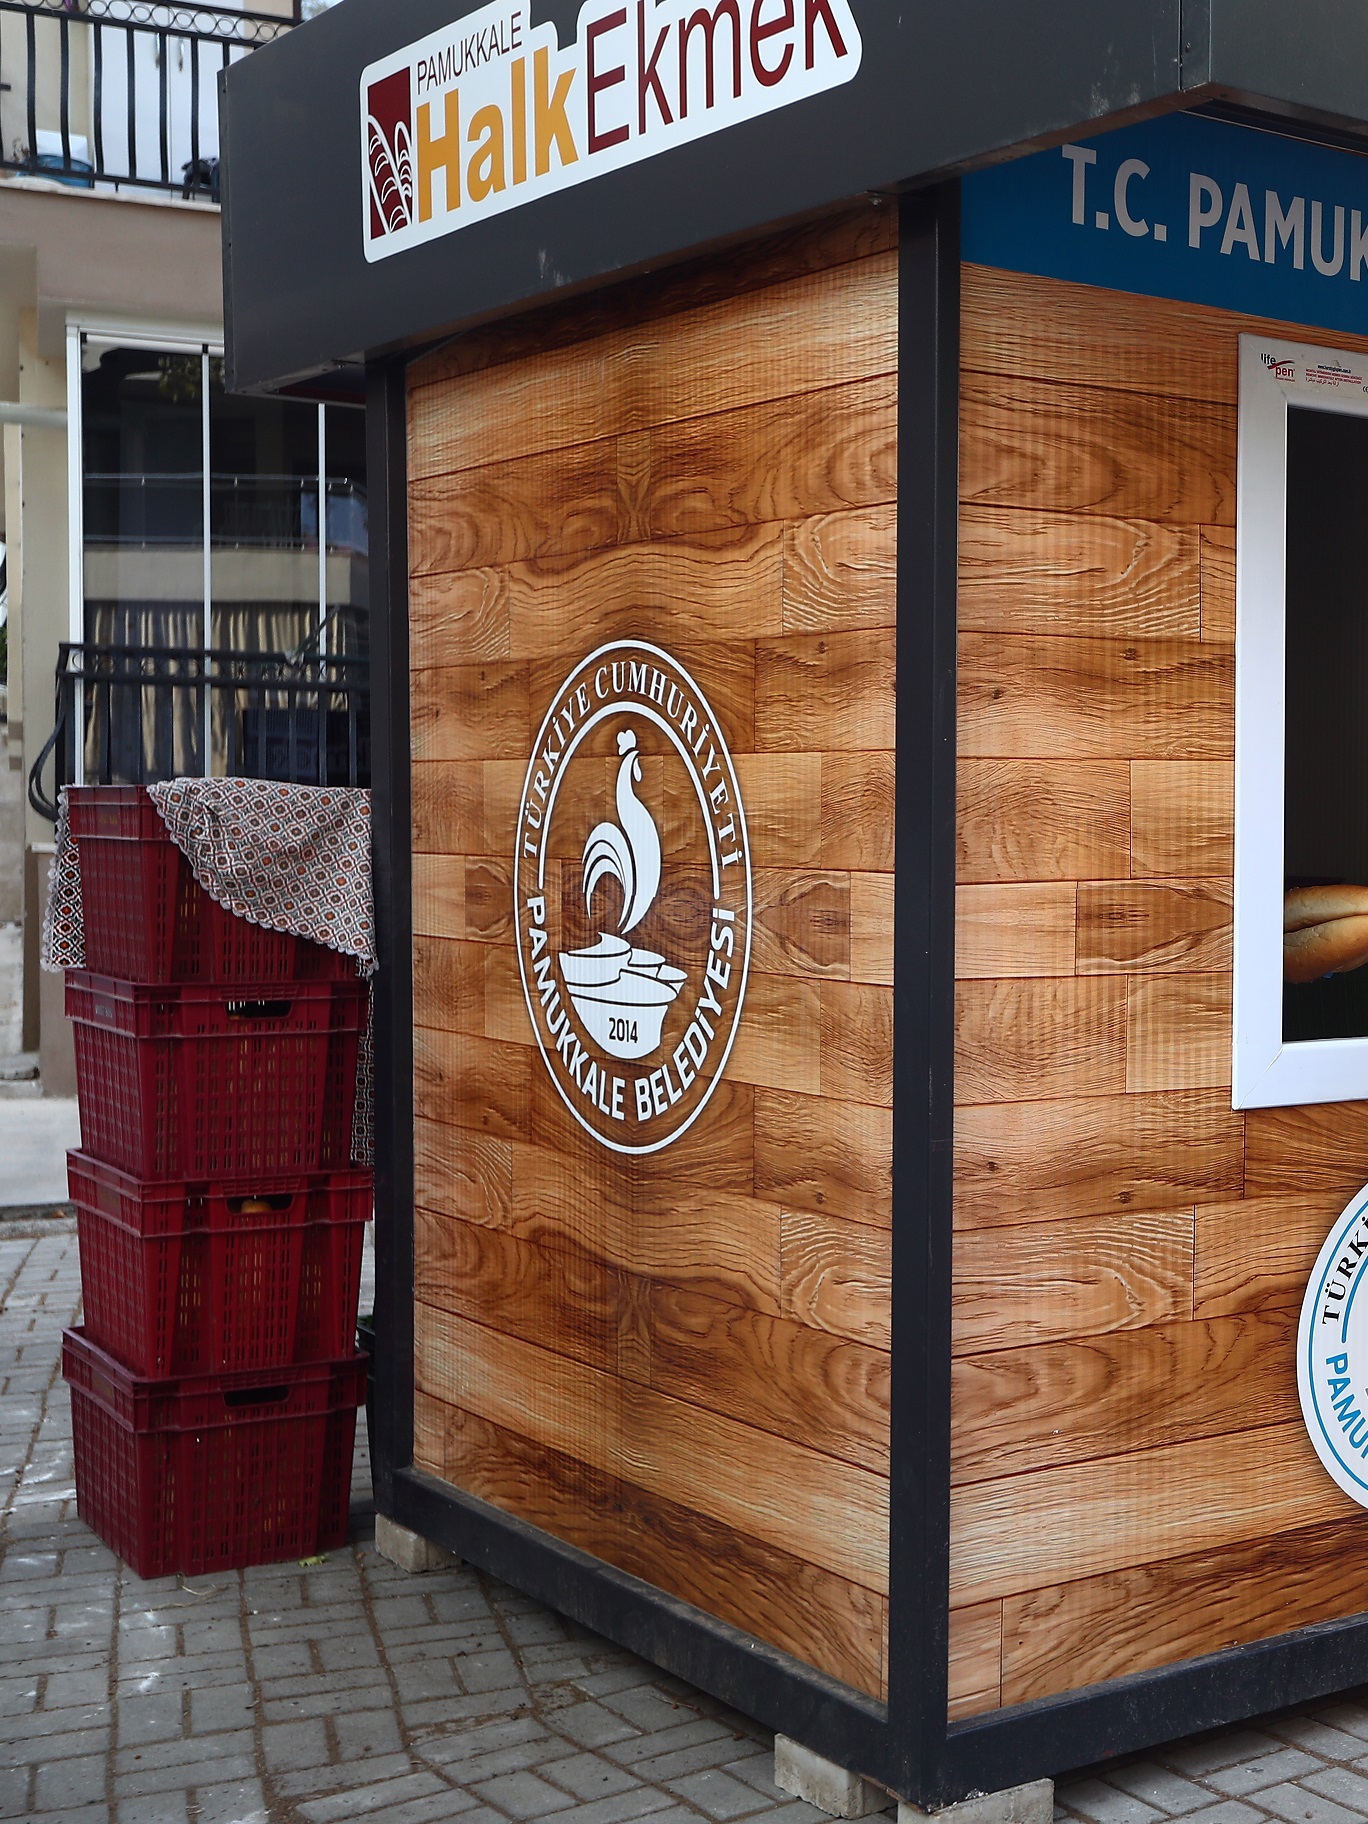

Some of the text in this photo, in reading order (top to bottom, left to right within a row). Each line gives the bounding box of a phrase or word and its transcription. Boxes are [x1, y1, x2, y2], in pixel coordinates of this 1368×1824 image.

[417, 11, 522, 95] PAMUKKALE
[416, 45, 579, 223] Halk
[1062, 144, 1168, 242] T.C.
[1275, 366, 1294, 378] pen
[523, 660, 743, 870] TÜRKİYE CUMHURİYETİ
[527, 896, 626, 1121] PAMUKKALE
[608, 1017, 639, 1043] 2014
